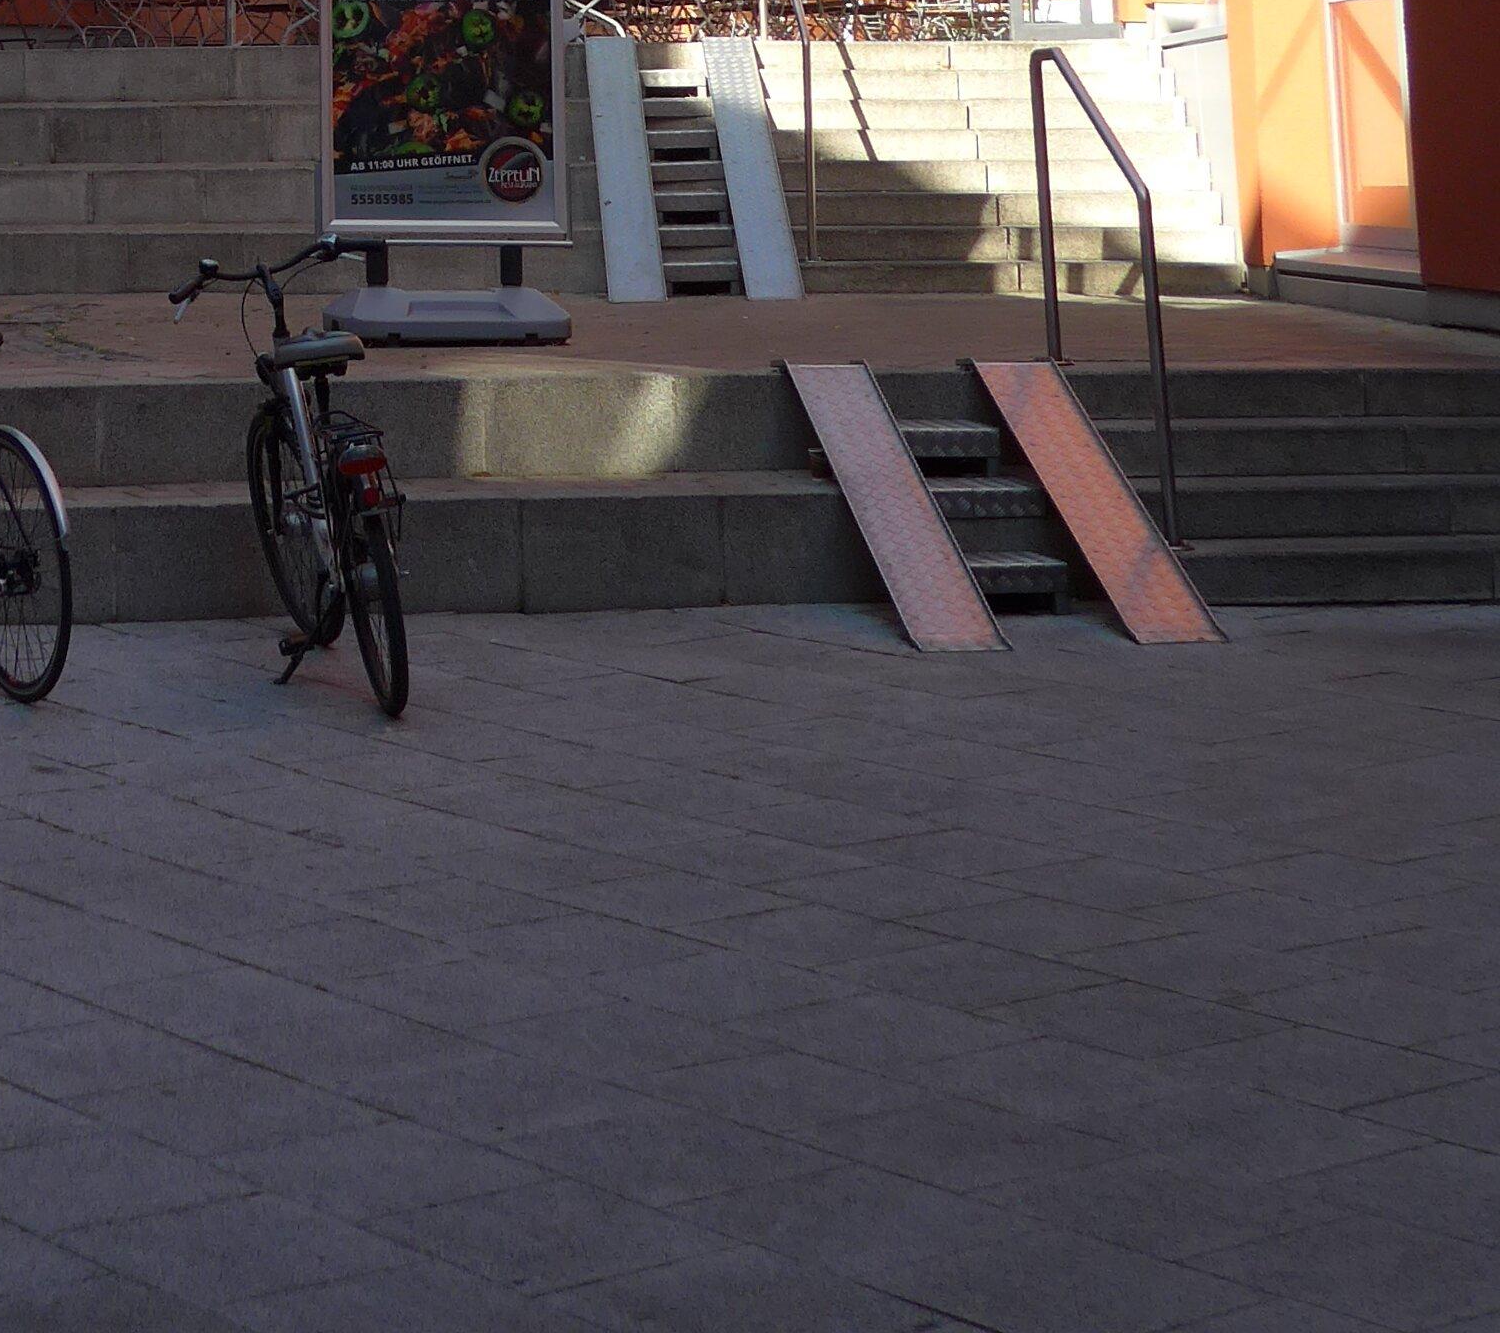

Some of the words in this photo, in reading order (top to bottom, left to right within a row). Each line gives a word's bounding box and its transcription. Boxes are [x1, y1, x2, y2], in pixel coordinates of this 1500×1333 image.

[350, 161, 365, 171] AB
[368, 159, 395, 170] 11:00
[397, 157, 420, 168] UHR
[351, 193, 414, 205] 55585985
